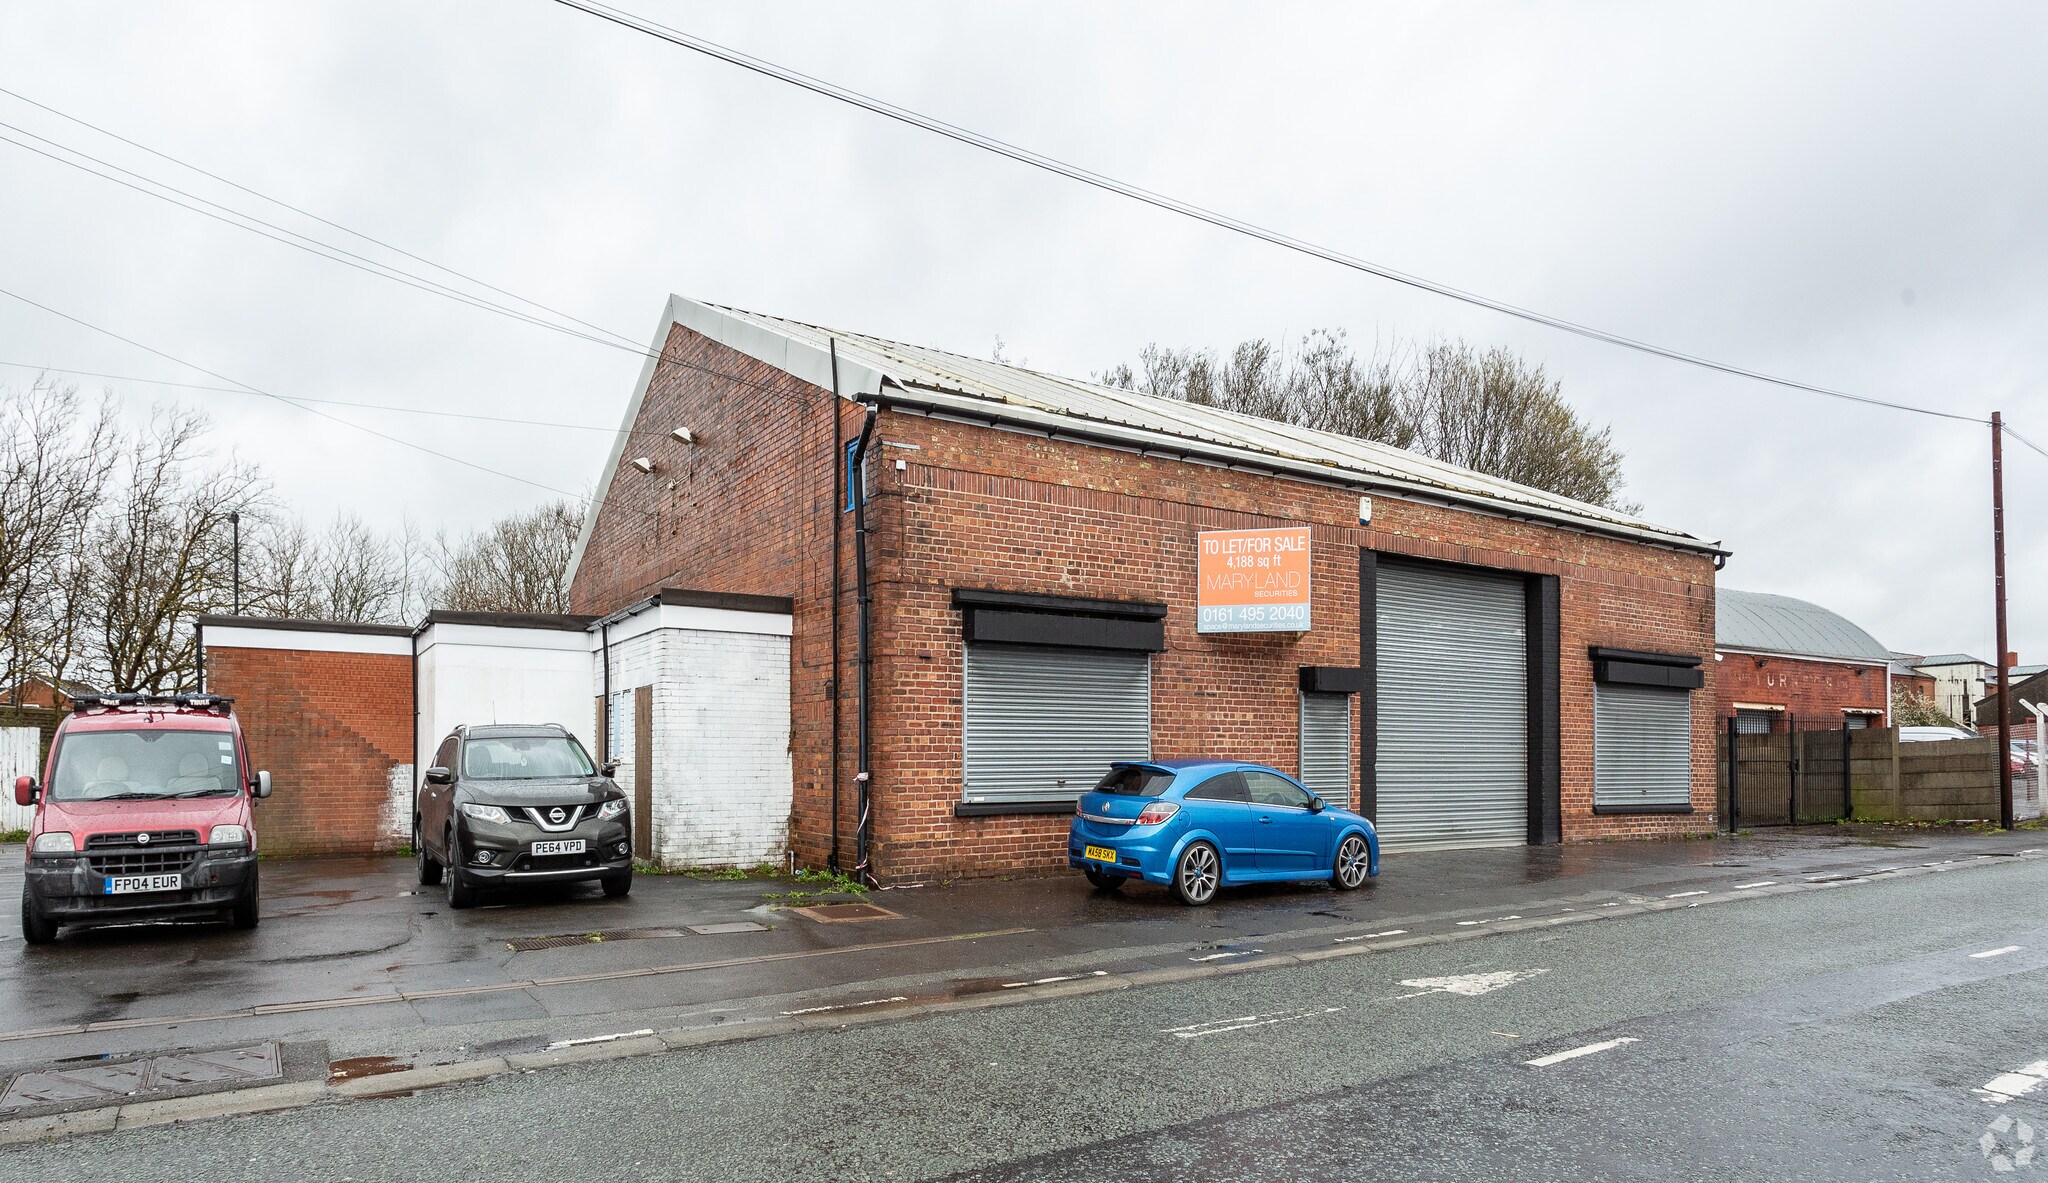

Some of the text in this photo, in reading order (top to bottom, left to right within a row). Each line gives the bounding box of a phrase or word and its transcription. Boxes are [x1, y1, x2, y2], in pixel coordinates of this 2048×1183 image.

[1203, 536, 1305, 554] TO LET/FOR SALE
[1227, 554, 1282, 569] 4,188 sq ft
[1206, 571, 1301, 591] MARYLAND
[1254, 590, 1298, 598] SECURITIES
[1203, 605, 1305, 622] 0161 495 2040
[535, 841, 582, 853] PE64 VPD
[114, 875, 178, 891] FP04 EUR
